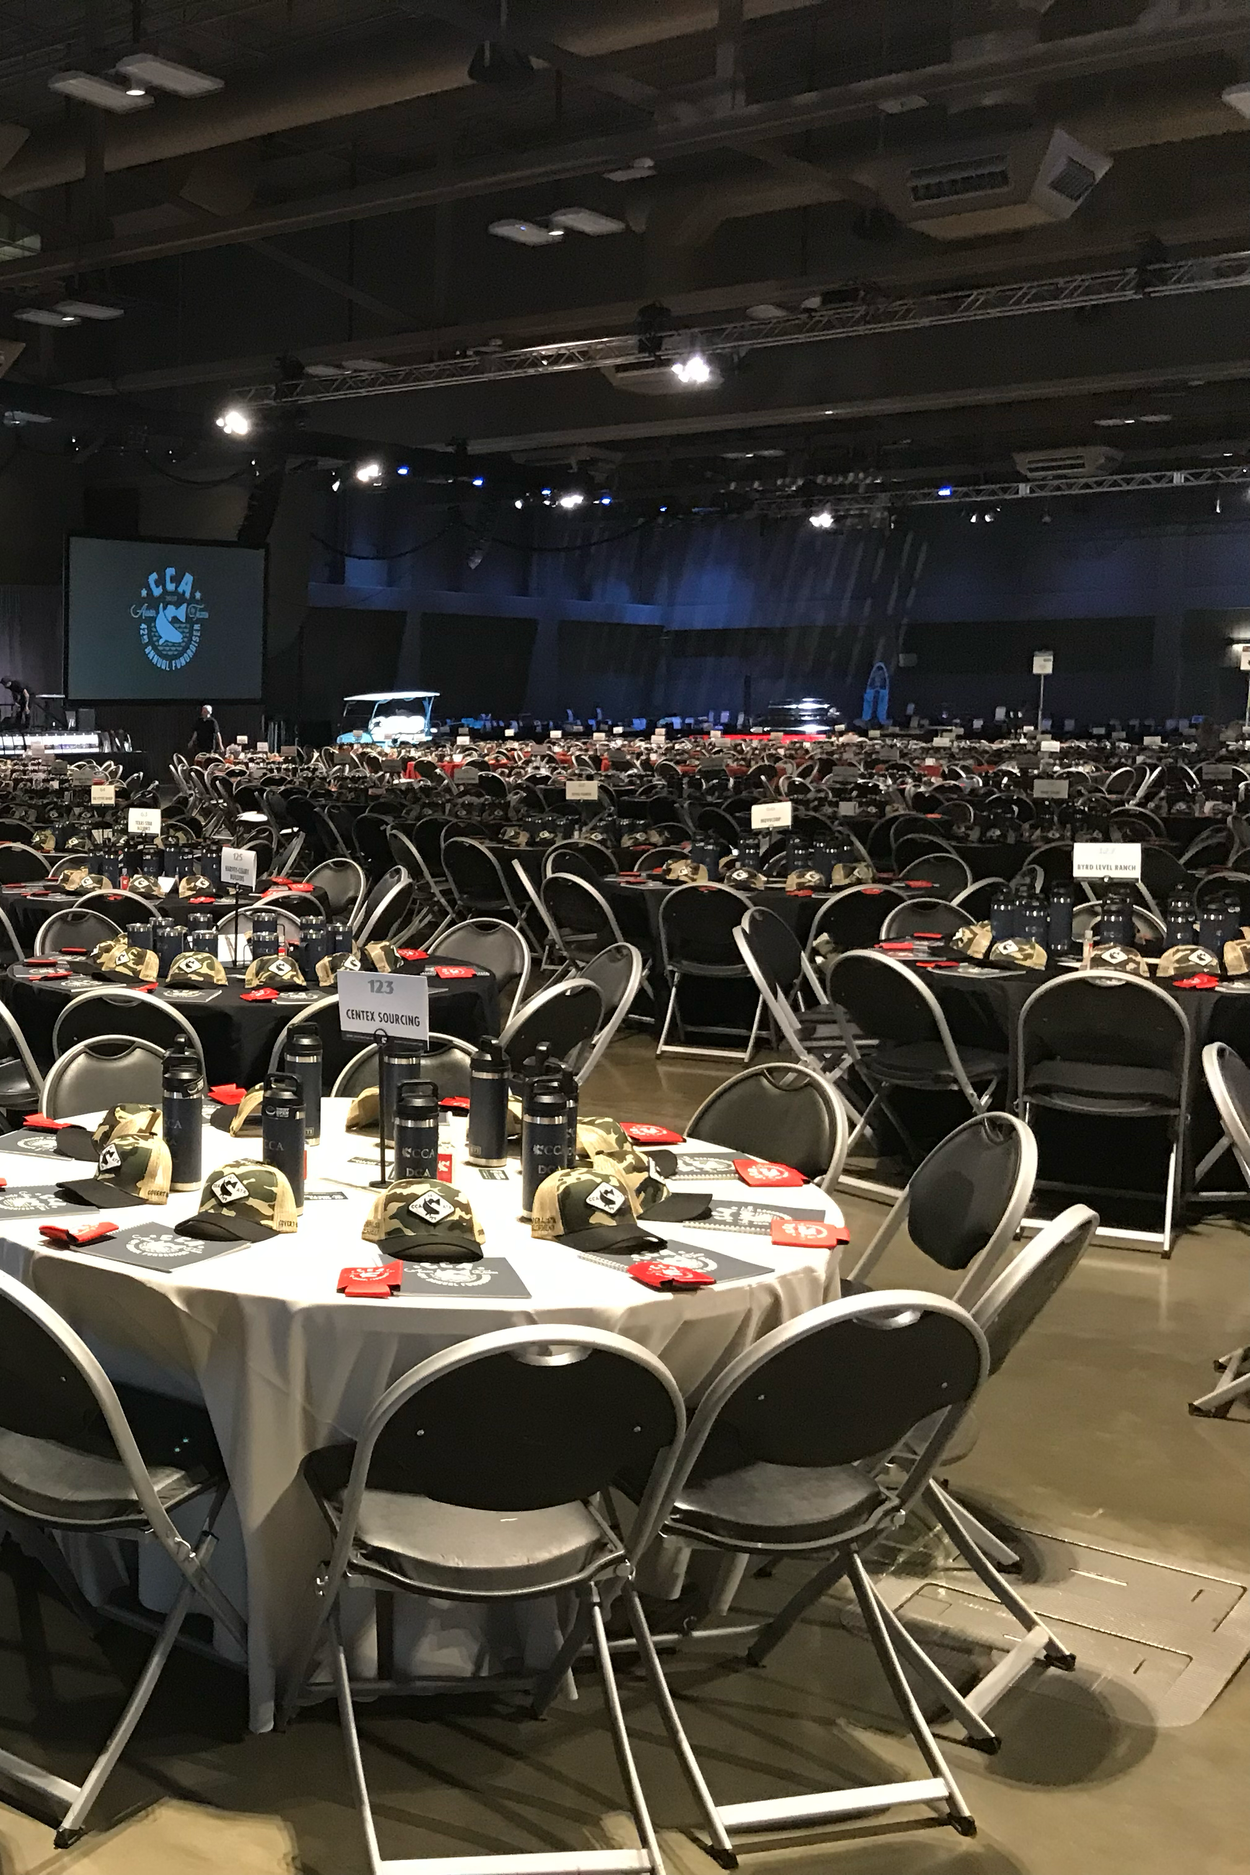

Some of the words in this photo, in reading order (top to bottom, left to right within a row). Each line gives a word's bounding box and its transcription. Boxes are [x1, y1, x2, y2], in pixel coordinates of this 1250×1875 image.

[147, 566, 194, 599] CCA
[145, 646, 171, 671] ANNUAL
[172, 624, 201, 671] FUNDRAISER
[233, 853, 243, 861] 125
[1115, 864, 1137, 872] RANCH
[367, 979, 395, 995] 123
[346, 1008, 376, 1022] CENTEX
[378, 1011, 421, 1027] SOURCING
[412, 1147, 435, 1158] CCA
[406, 1167, 431, 1177] DCA
